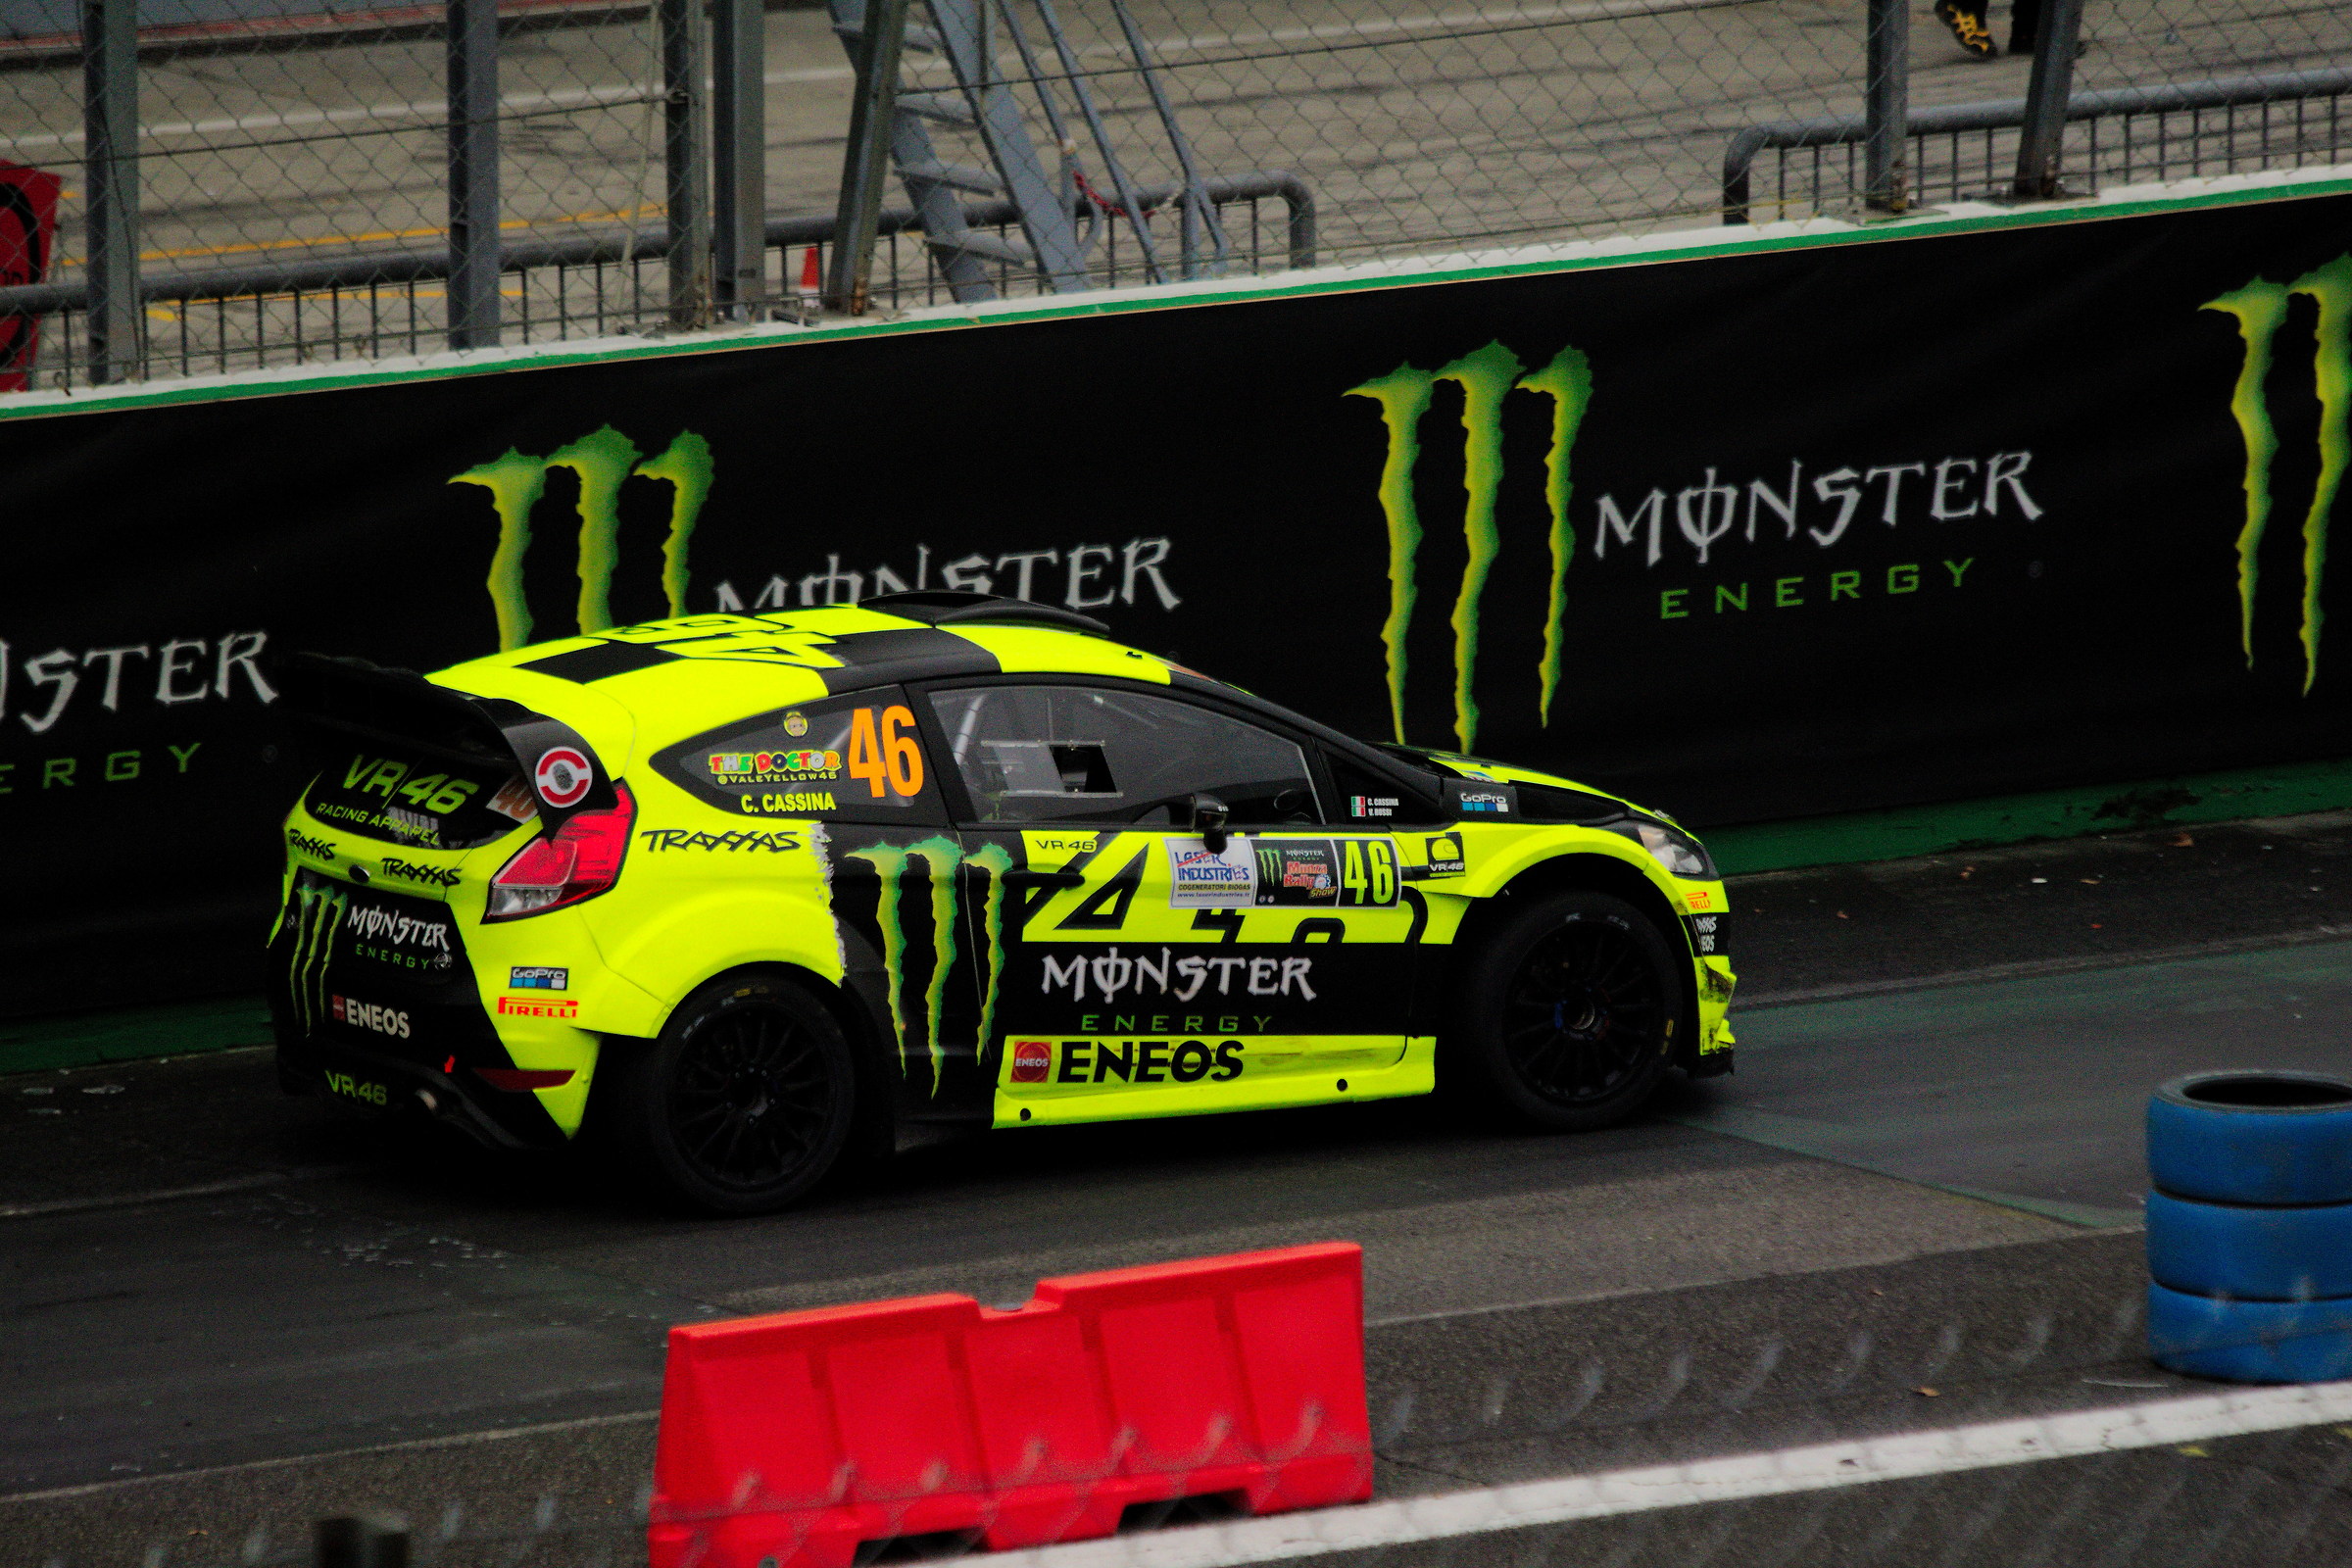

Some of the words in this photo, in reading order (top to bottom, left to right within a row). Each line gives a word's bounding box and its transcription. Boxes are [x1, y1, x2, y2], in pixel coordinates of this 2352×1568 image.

[1593, 450, 2043, 567] MONSTER
[1662, 558, 1974, 619] ENERGY
[709, 754, 754, 774] THE
[755, 750, 842, 774] DOCTOR
[849, 706, 924, 798] 46
[717, 771, 837, 784] @VALEYELLOW46
[741, 795, 760, 812] C.
[762, 792, 836, 812] CASSINA
[1460, 793, 1506, 804] GoPro
[317, 803, 368, 823] RACING
[368, 814, 440, 846] APPAREL
[641, 829, 801, 854] TRAXXAS
[381, 857, 463, 887] TRAXXAS
[1178, 864, 1250, 882] INDUSTRIES
[1345, 841, 1394, 904] 46
[348, 905, 450, 952] MONSTER
[356, 944, 429, 969] ENERGY
[512, 967, 566, 979] GoPro
[1041, 947, 1316, 1004] MONSTER
[346, 998, 411, 1039] ENEOS
[498, 997, 578, 1018] PIRELLI
[1081, 1014, 1272, 1032] ENERGY
[1015, 1056, 1049, 1067] ENEOS
[1056, 1040, 1245, 1083] ENEOS
